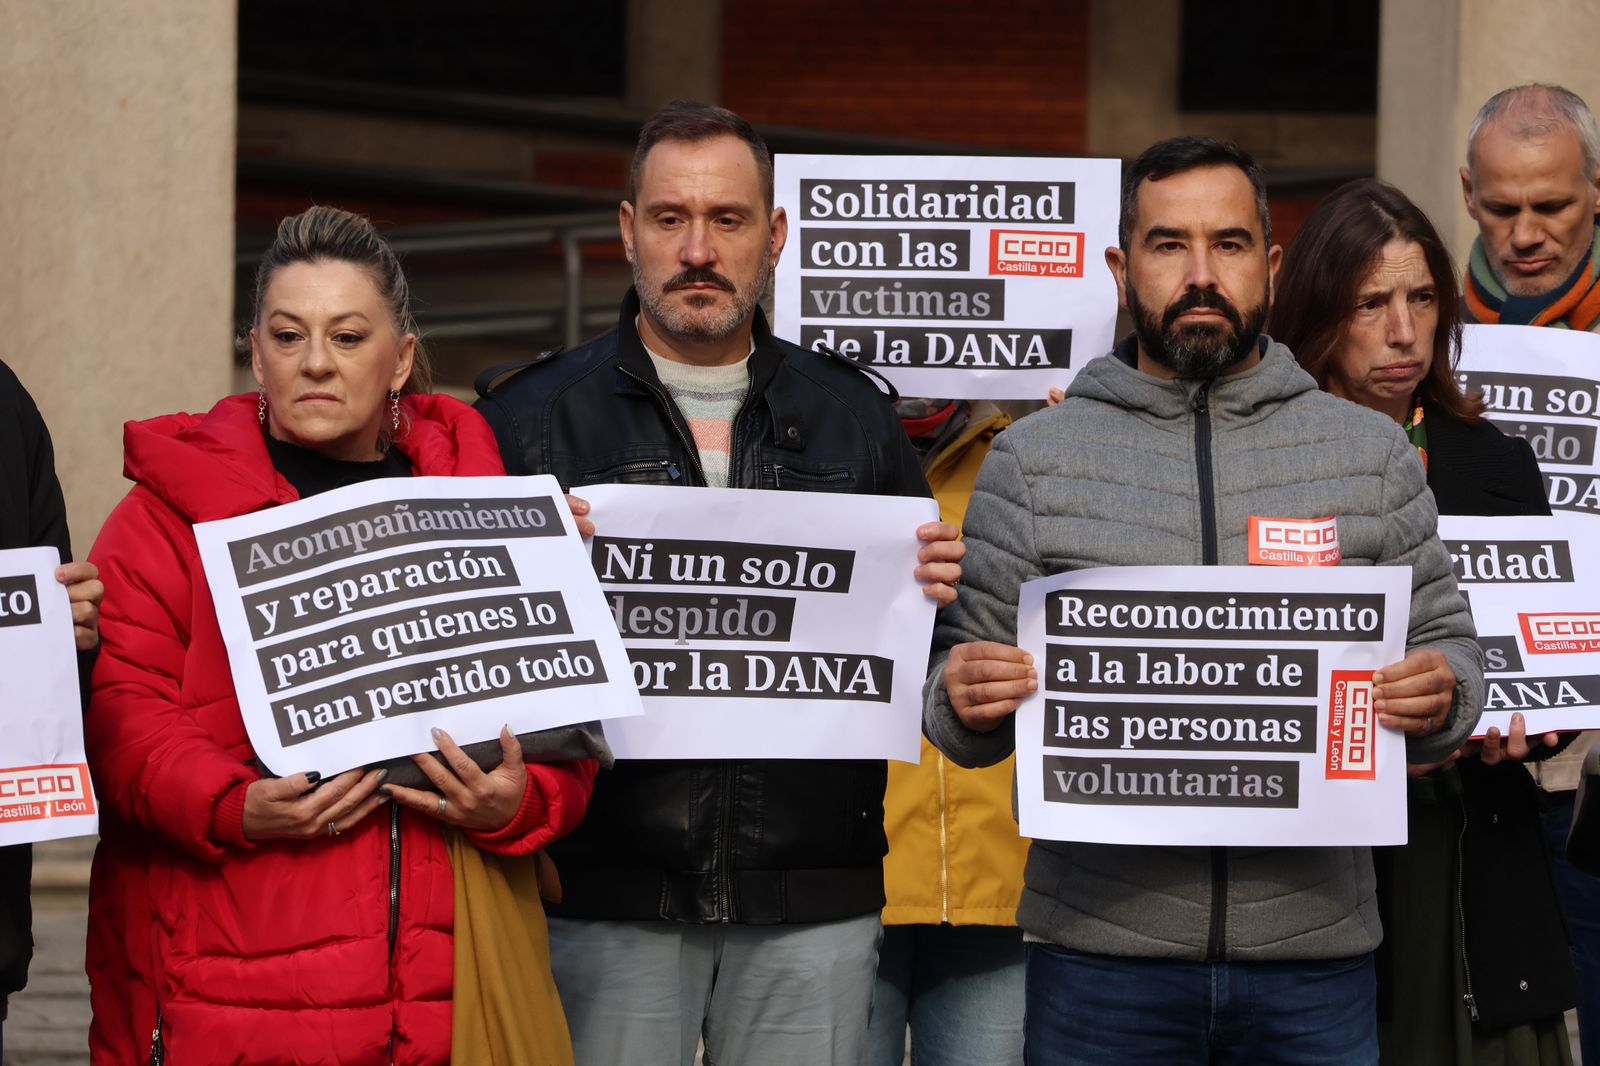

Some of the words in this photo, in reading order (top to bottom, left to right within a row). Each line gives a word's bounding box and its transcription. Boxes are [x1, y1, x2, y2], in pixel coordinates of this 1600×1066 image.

[810, 184, 1063, 220] Solidaridad
[811, 239, 893, 267] con
[899, 233, 958, 267] las
[1004, 240, 1070, 256] CCOO
[997, 261, 1037, 273] Castilla
[1040, 265, 1047, 275] y
[1049, 263, 1076, 274] León
[810, 281, 991, 317] víctimas
[811, 329, 861, 361] de
[872, 330, 911, 364] la
[924, 333, 1052, 366] DANA
[1481, 384, 1534, 411] un
[246, 503, 547, 574] Acompañamiento
[1265, 526, 1335, 545] CCOO
[601, 543, 653, 580] Ni
[669, 554, 726, 582] un
[740, 552, 836, 588] solo
[1259, 549, 1304, 563] Castilla
[1307, 556, 1314, 565] y
[256, 602, 281, 635] y
[290, 552, 506, 615] reparación
[1058, 597, 1379, 632] Reconocimiento
[271, 634, 364, 688] para
[372, 605, 517, 658] quienes
[519, 598, 556, 626] lo
[1535, 641, 1577, 650] Castilla
[1579, 641, 1586, 651] y
[631, 661, 677, 690] or
[688, 652, 731, 691] la
[744, 655, 880, 695] DANA
[1056, 658, 1077, 683] a
[1089, 652, 1125, 684] la
[1136, 653, 1244, 686] labor
[1256, 655, 1302, 687] de
[284, 694, 362, 736] han
[366, 660, 511, 721] perdido
[516, 649, 594, 683] todo
[1333, 681, 1346, 726] Castilla
[1484, 681, 1589, 709] ANA
[1054, 706, 1110, 739] las
[1120, 713, 1301, 749] personas
[1331, 729, 1341, 737] y
[1349, 688, 1368, 763] CCOO
[1330, 740, 1342, 771] León
[1054, 764, 1284, 798] voluntarias
[0, 804, 41, 818] astilla
[56, 800, 86, 812] León
